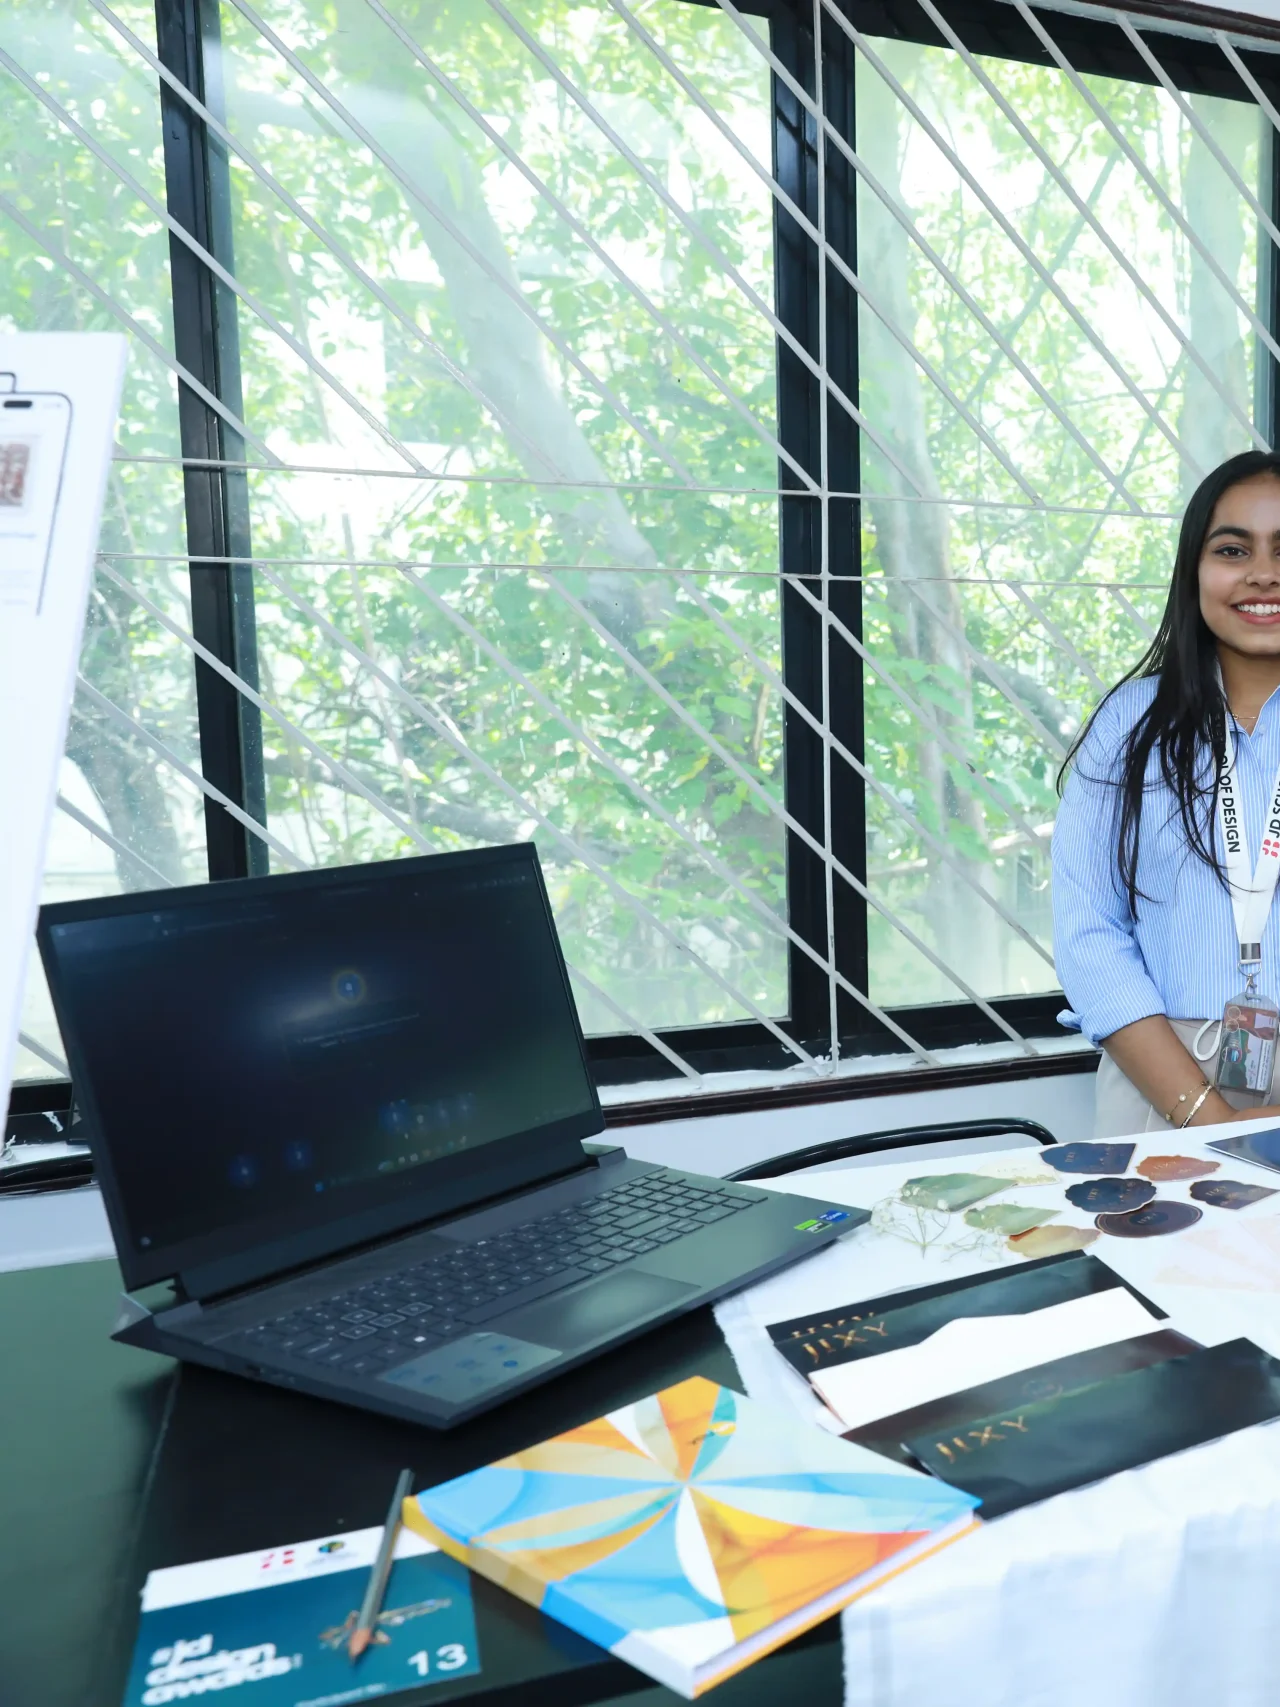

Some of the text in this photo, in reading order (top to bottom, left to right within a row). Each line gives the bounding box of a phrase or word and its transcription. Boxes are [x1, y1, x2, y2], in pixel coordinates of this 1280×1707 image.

[1219, 775, 1233, 794] OF
[1222, 797, 1241, 853] DESIGN
[802, 1321, 889, 1365] JIXY
[935, 1415, 1029, 1465] JIXY
[407, 1642, 468, 1676] 13
